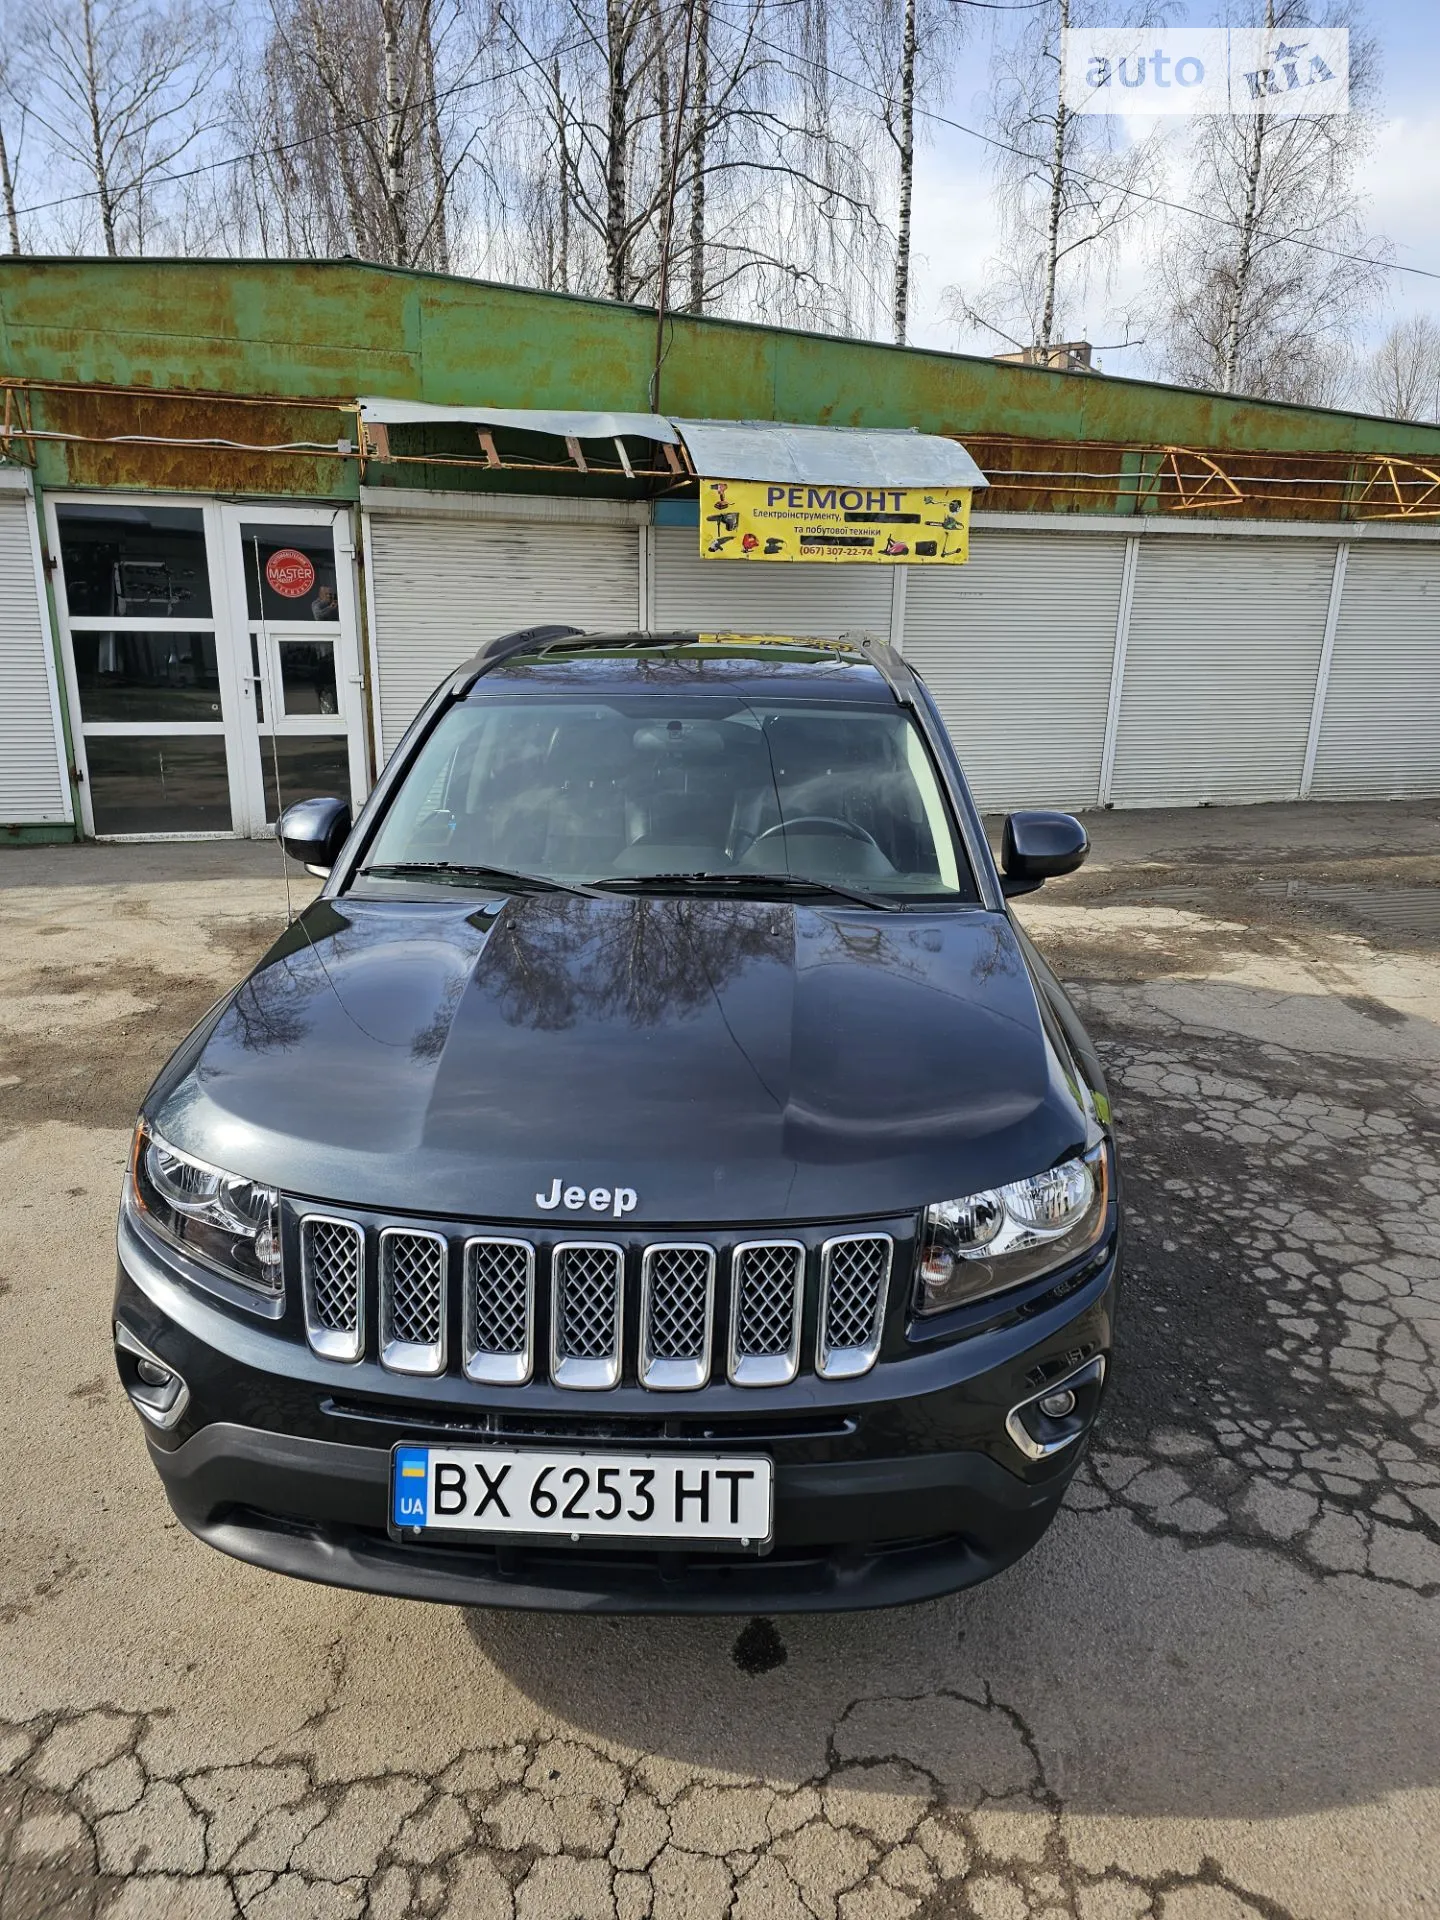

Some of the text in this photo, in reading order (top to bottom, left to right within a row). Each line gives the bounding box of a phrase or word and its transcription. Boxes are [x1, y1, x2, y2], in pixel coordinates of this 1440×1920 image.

[767, 486, 907, 512] РЕМОНТ
[753, 508, 842, 521] Електроінструменту,
[794, 525, 881, 536] та побутової техніки
[800, 546, 873, 557] (067) 307-22-74
[269, 568, 312, 579] MASTER
[535, 1178, 638, 1218] Jeep
[433, 1462, 755, 1525] BX 6253 HT
[400, 1499, 424, 1516] UA
